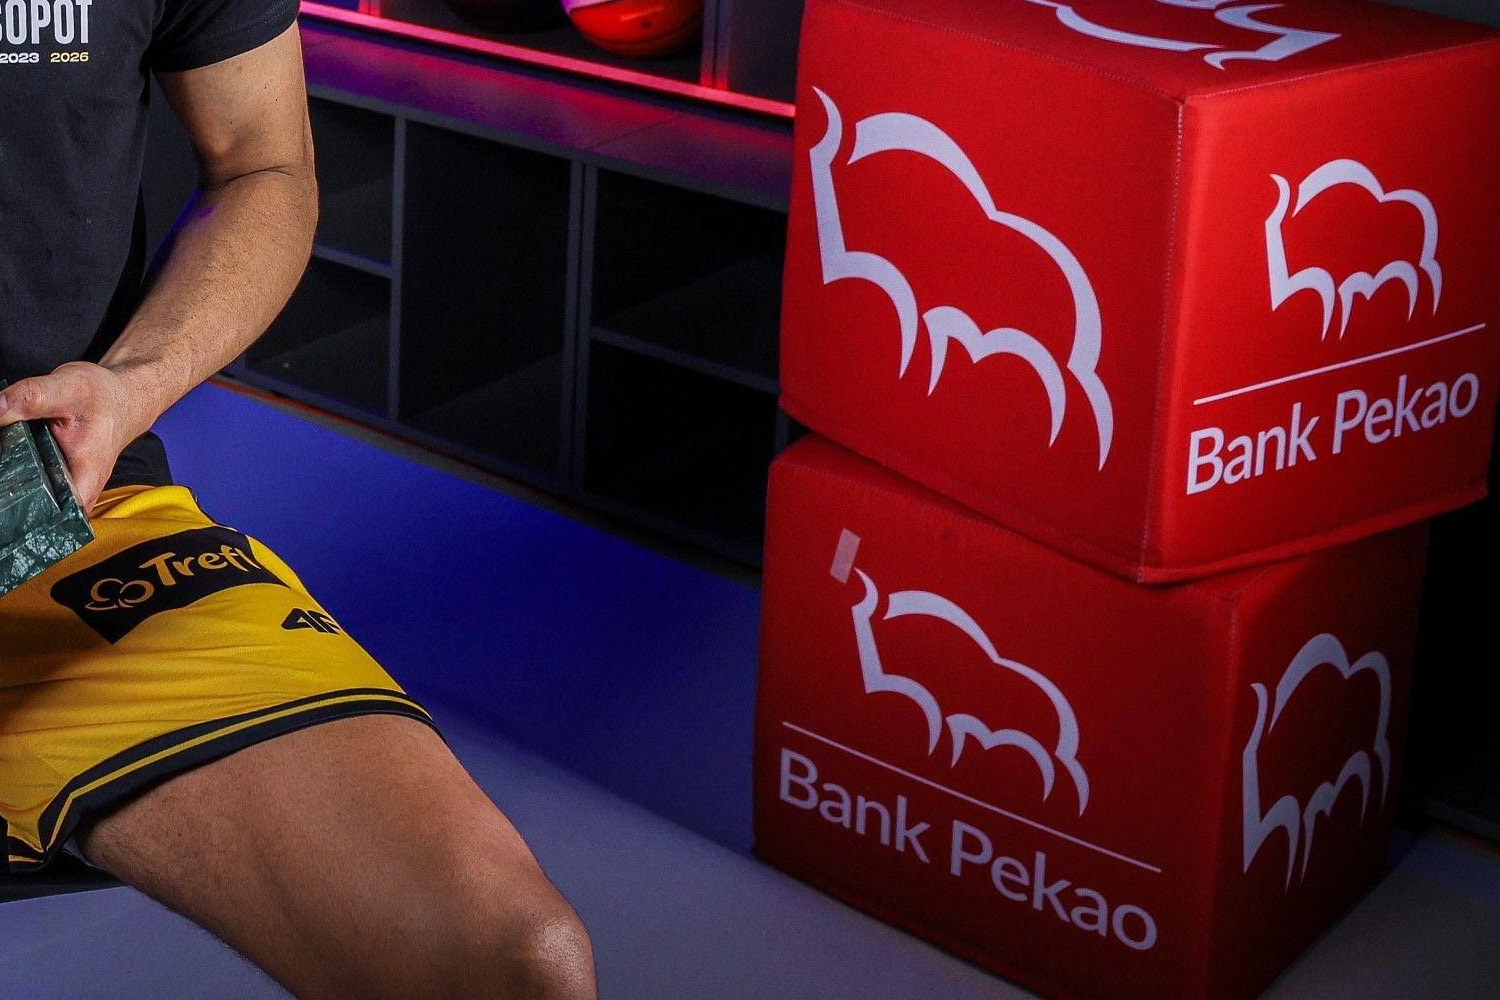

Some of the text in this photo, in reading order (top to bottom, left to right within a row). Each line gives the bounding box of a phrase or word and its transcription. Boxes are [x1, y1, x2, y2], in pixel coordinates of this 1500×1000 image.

[50, 51, 90, 64] 2026
[1187, 373, 1480, 495] Bank Pekao
[138, 544, 261, 586] Trefl
[779, 747, 1158, 951] Bank Pekao
